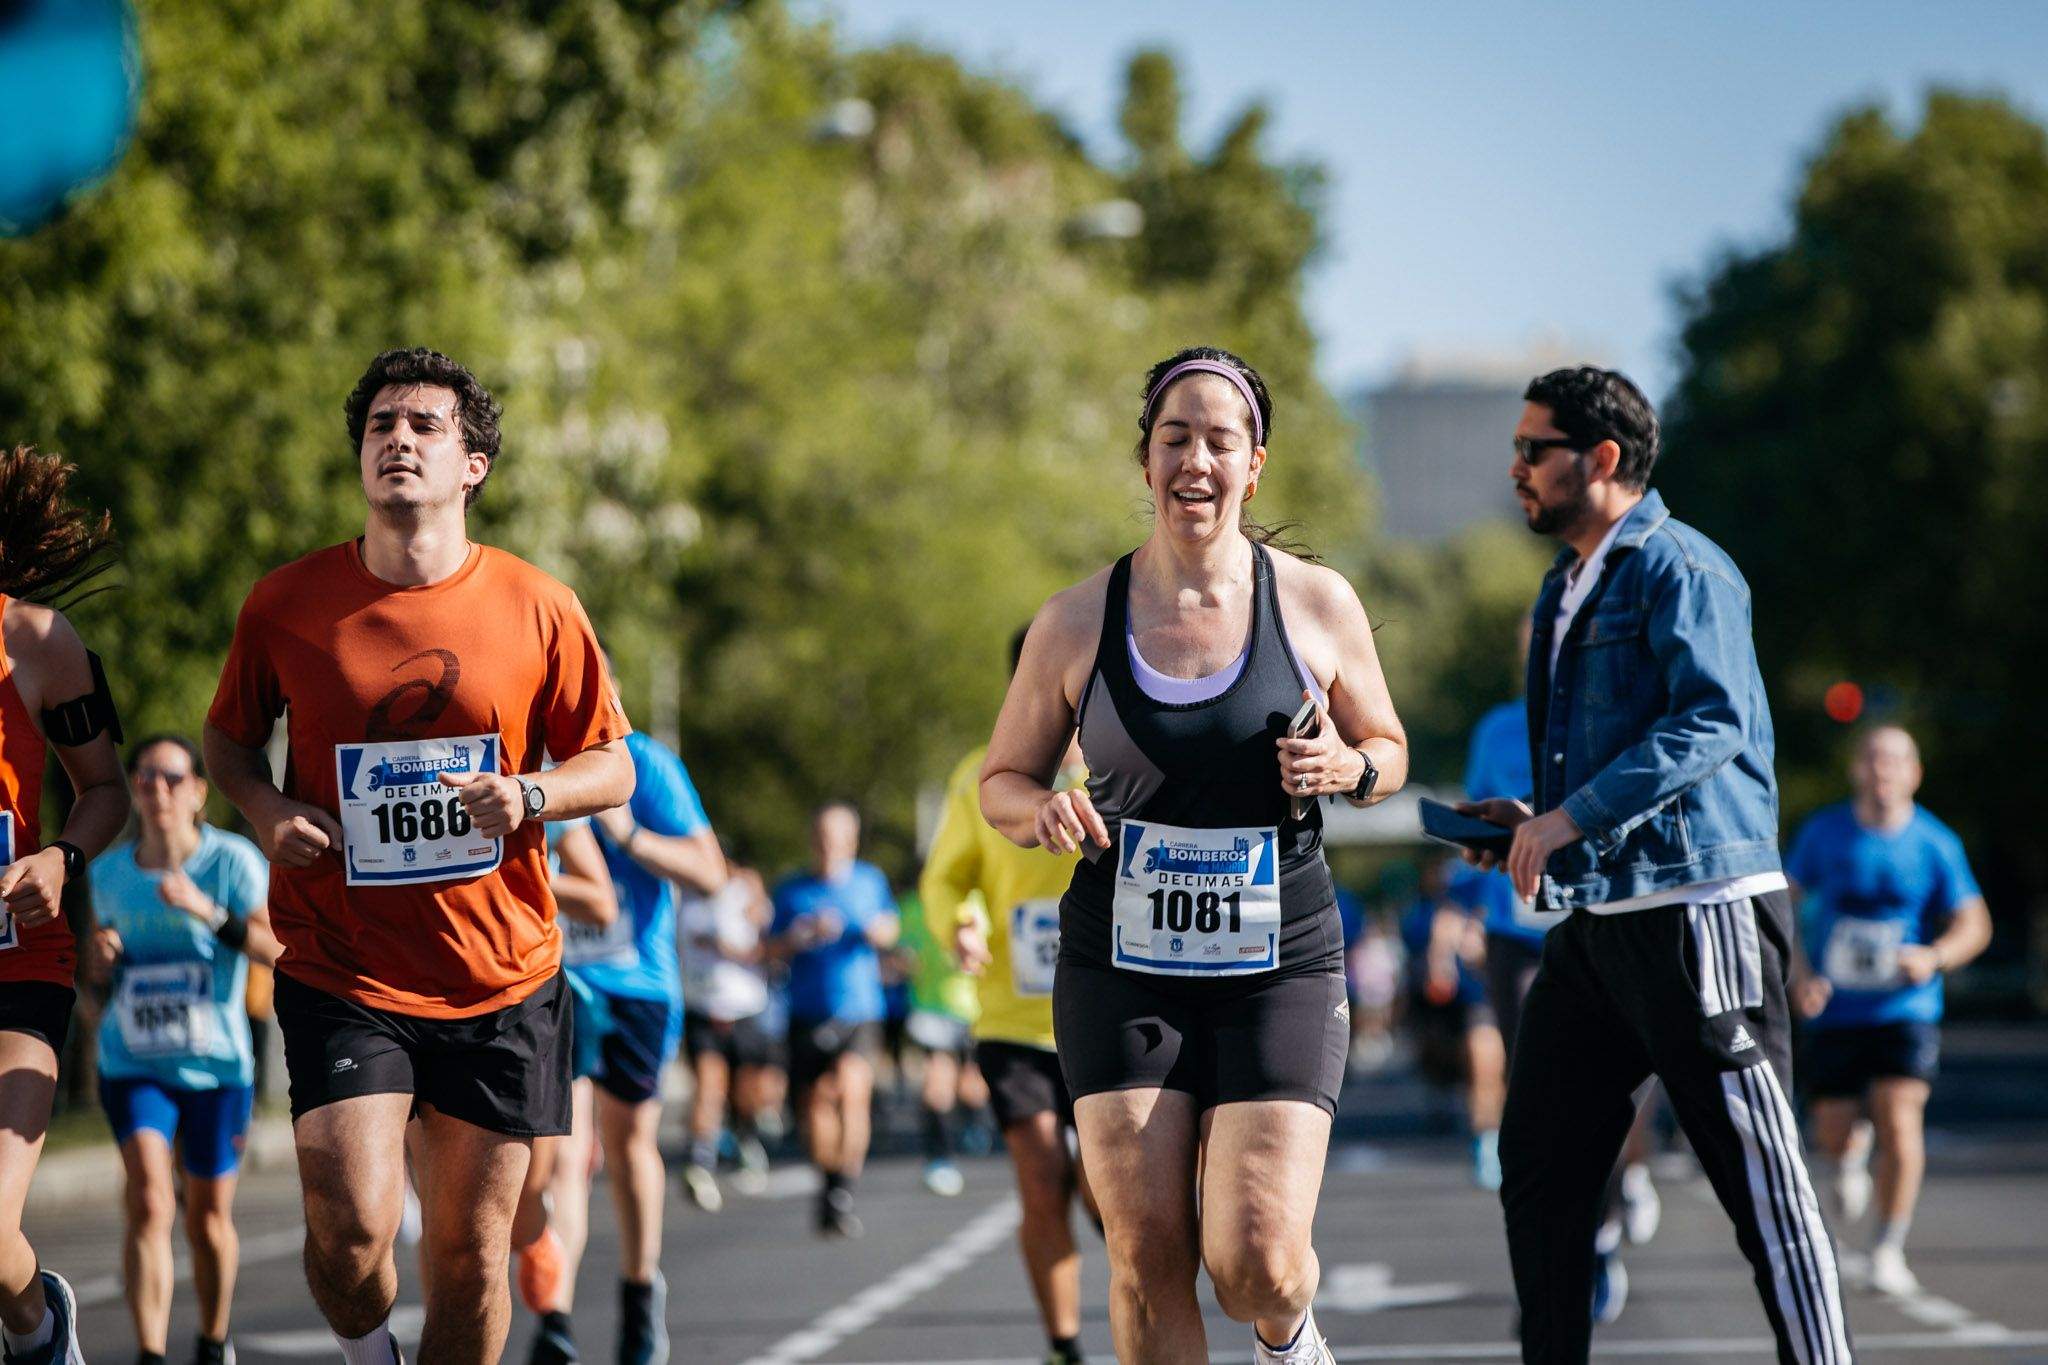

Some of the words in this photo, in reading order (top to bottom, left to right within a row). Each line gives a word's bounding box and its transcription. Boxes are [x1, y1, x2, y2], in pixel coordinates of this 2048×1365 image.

[392, 755, 420, 763] CARRERA
[392, 757, 468, 774] BOMBEROS
[385, 783, 463, 798] DECIMA
[371, 797, 471, 844] 1686
[1169, 841, 1198, 849] CARRERA
[1168, 850, 1247, 862] BOMBEROS
[1212, 862, 1247, 873] MADRID
[1158, 872, 1244, 888] DECIMAS
[1147, 888, 1241, 934] 1081
